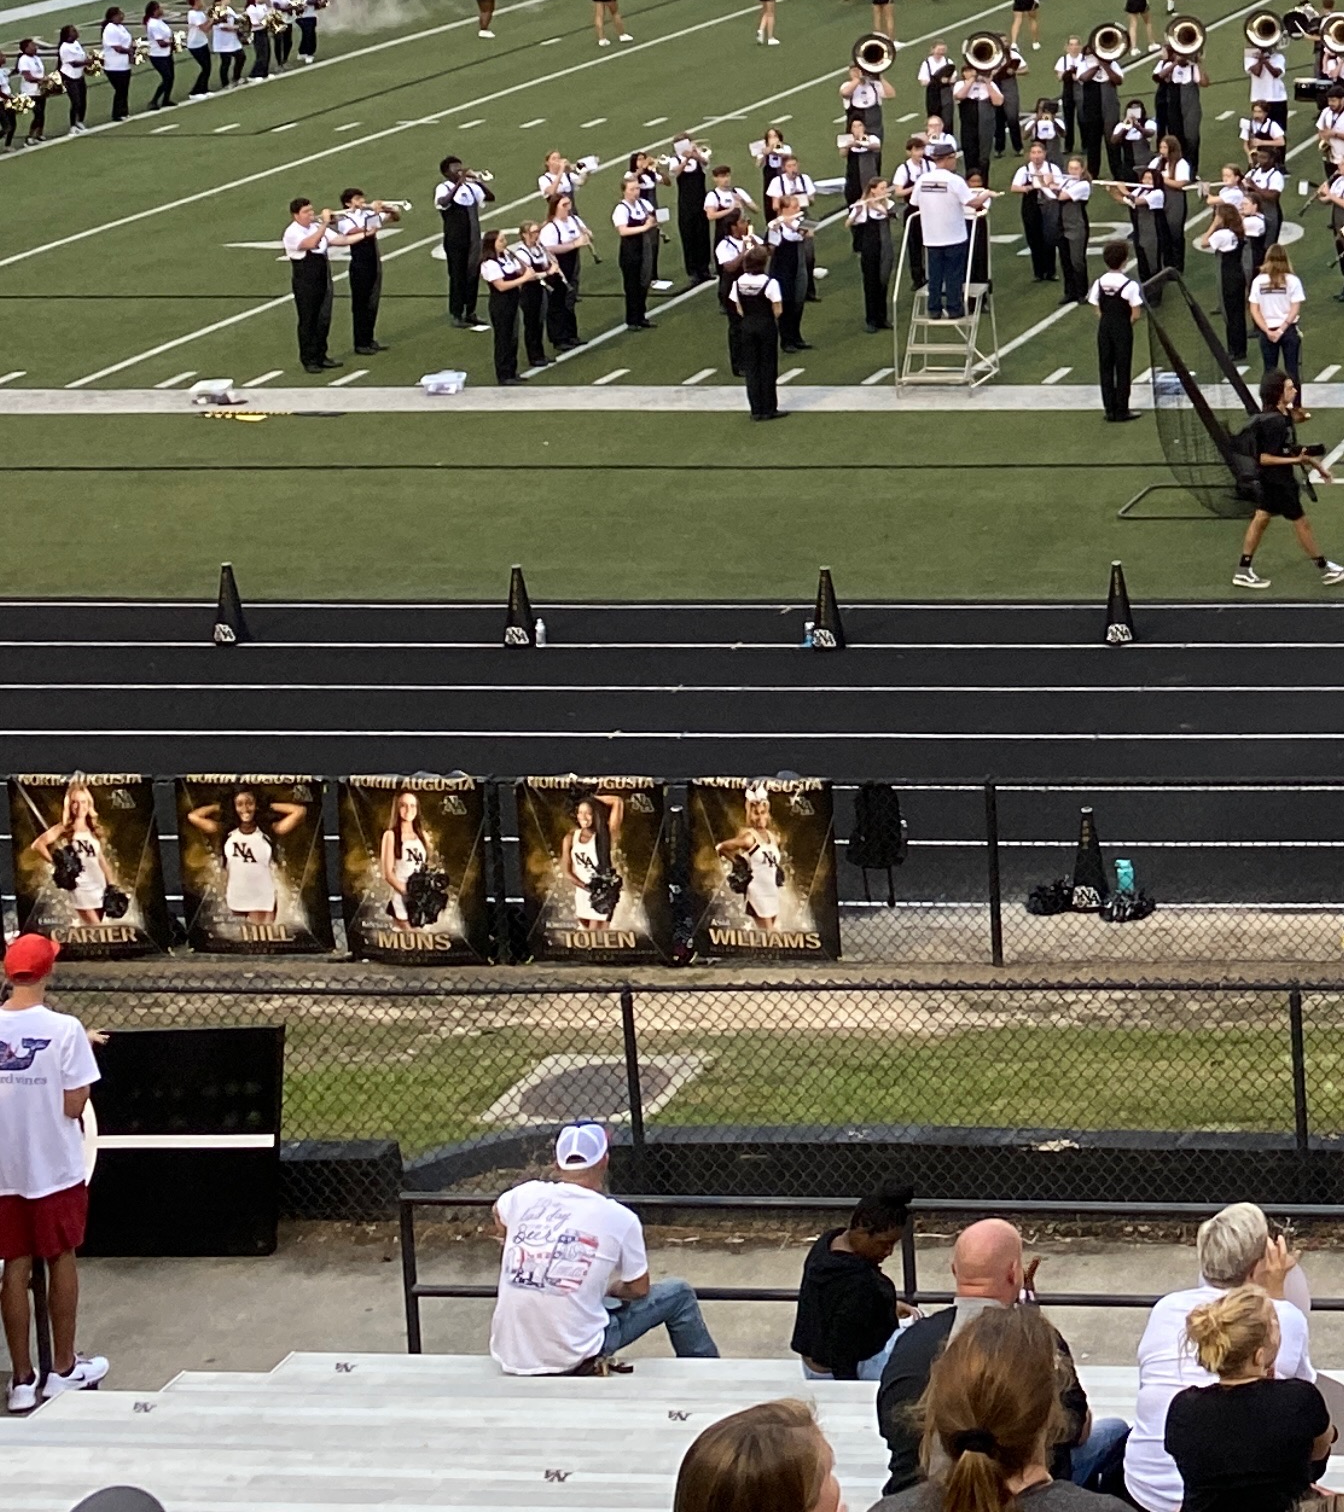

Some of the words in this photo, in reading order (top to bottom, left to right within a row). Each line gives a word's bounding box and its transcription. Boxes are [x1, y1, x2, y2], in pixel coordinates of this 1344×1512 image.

[76, 840, 96, 857] NA
[232, 842, 257, 863] NA
[575, 852, 596, 869] NA
[52, 926, 138, 944] CARTER
[240, 924, 296, 943] HILL
[377, 931, 453, 950] MUNS
[561, 931, 637, 950] TOLEN
[708, 928, 823, 950] WILLIAMS
